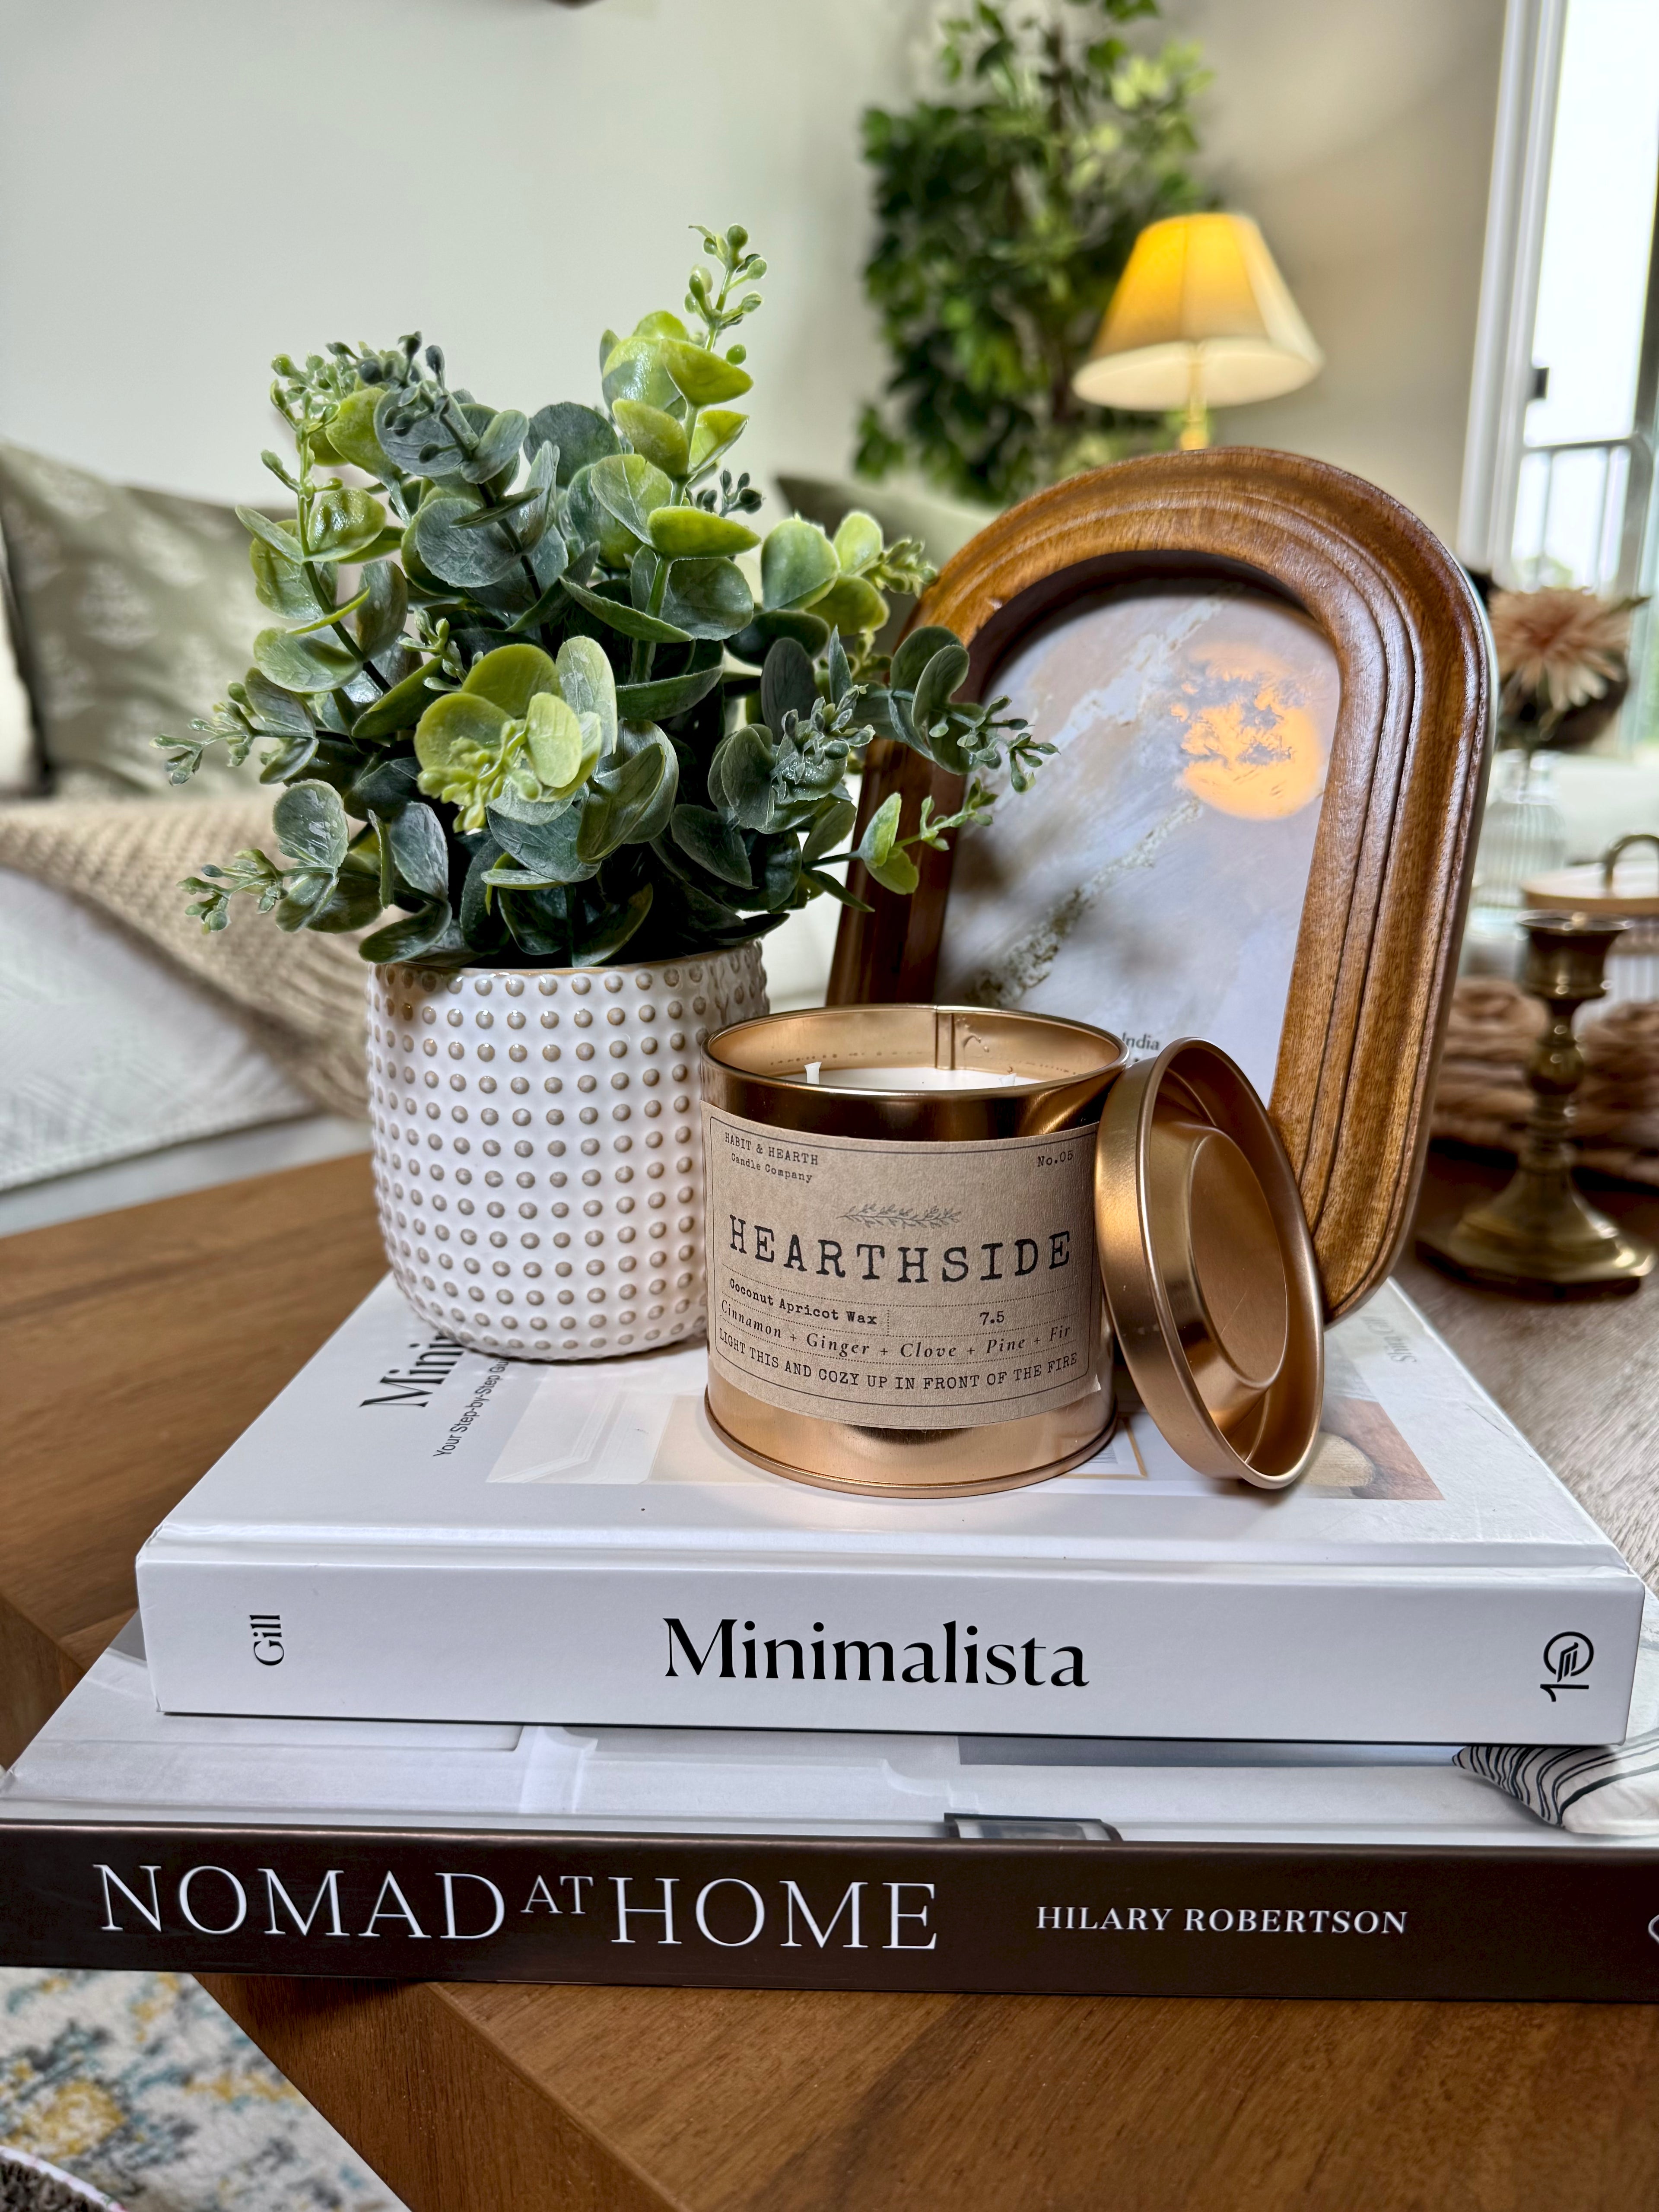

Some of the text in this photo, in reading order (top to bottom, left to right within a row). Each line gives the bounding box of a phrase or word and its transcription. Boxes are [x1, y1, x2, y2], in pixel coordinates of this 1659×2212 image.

[1122, 1032, 1160, 1050] India
[725, 1132, 818, 1165] HABIT & HEARTH
[731, 1153, 812, 1183] Candle Company
[1037, 1150, 1073, 1167] No.05
[729, 1214, 1070, 1283] HEARTHSIDE
[730, 1278, 877, 1325] Coconut Apricot Wax
[979, 1311, 1005, 1325] 7.5
[721, 1300, 782, 1338] Cinnamon
[807, 1333, 869, 1357] Ginger
[900, 1342, 957, 1357] Clove
[986, 1338, 1026, 1354] Pine
[1050, 1325, 1071, 1341] Fir
[360, 1332, 467, 1407] Mini
[719, 1328, 1077, 1390] LIGHT THIS AND COZY UP IN FRONT OF THE FIRE
[433, 1434, 462, 1456] Your
[450, 1375, 503, 1432] Step-by-Step
[249, 1615, 284, 1665] Gill
[662, 1618, 1090, 1687] Minimalista
[92, 1864, 938, 1949] NOMAD AT HOME
[1036, 1906, 1408, 1935] HILARY ROBERTSON
